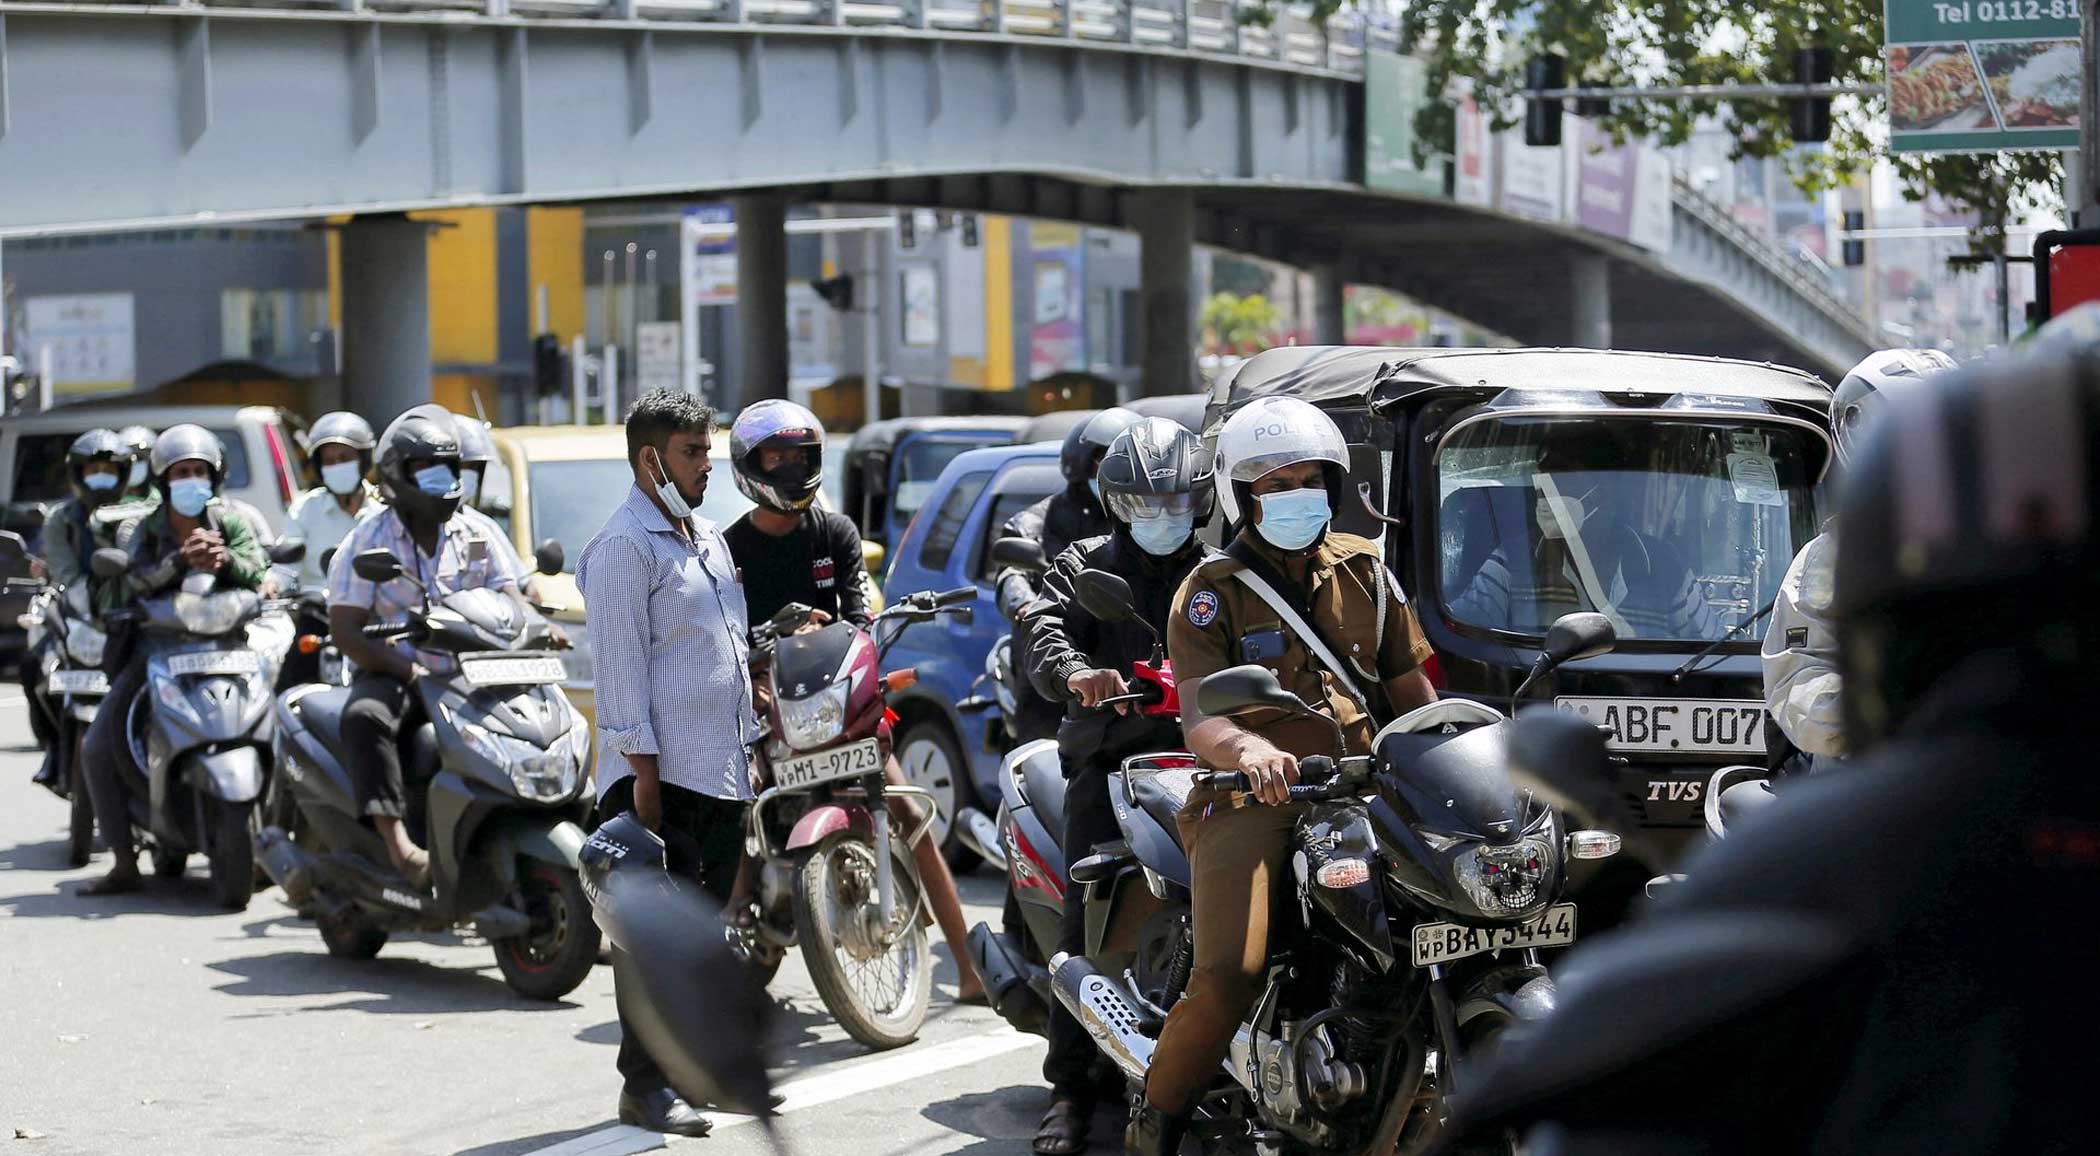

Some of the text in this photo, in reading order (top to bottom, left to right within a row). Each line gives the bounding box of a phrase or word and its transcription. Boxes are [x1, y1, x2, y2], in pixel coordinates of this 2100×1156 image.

[1934, 3, 1971, 24] Tel
[1254, 421, 1322, 441] POLIE
[1604, 705, 1676, 743] ABF
[1647, 781, 1702, 801] TVS
